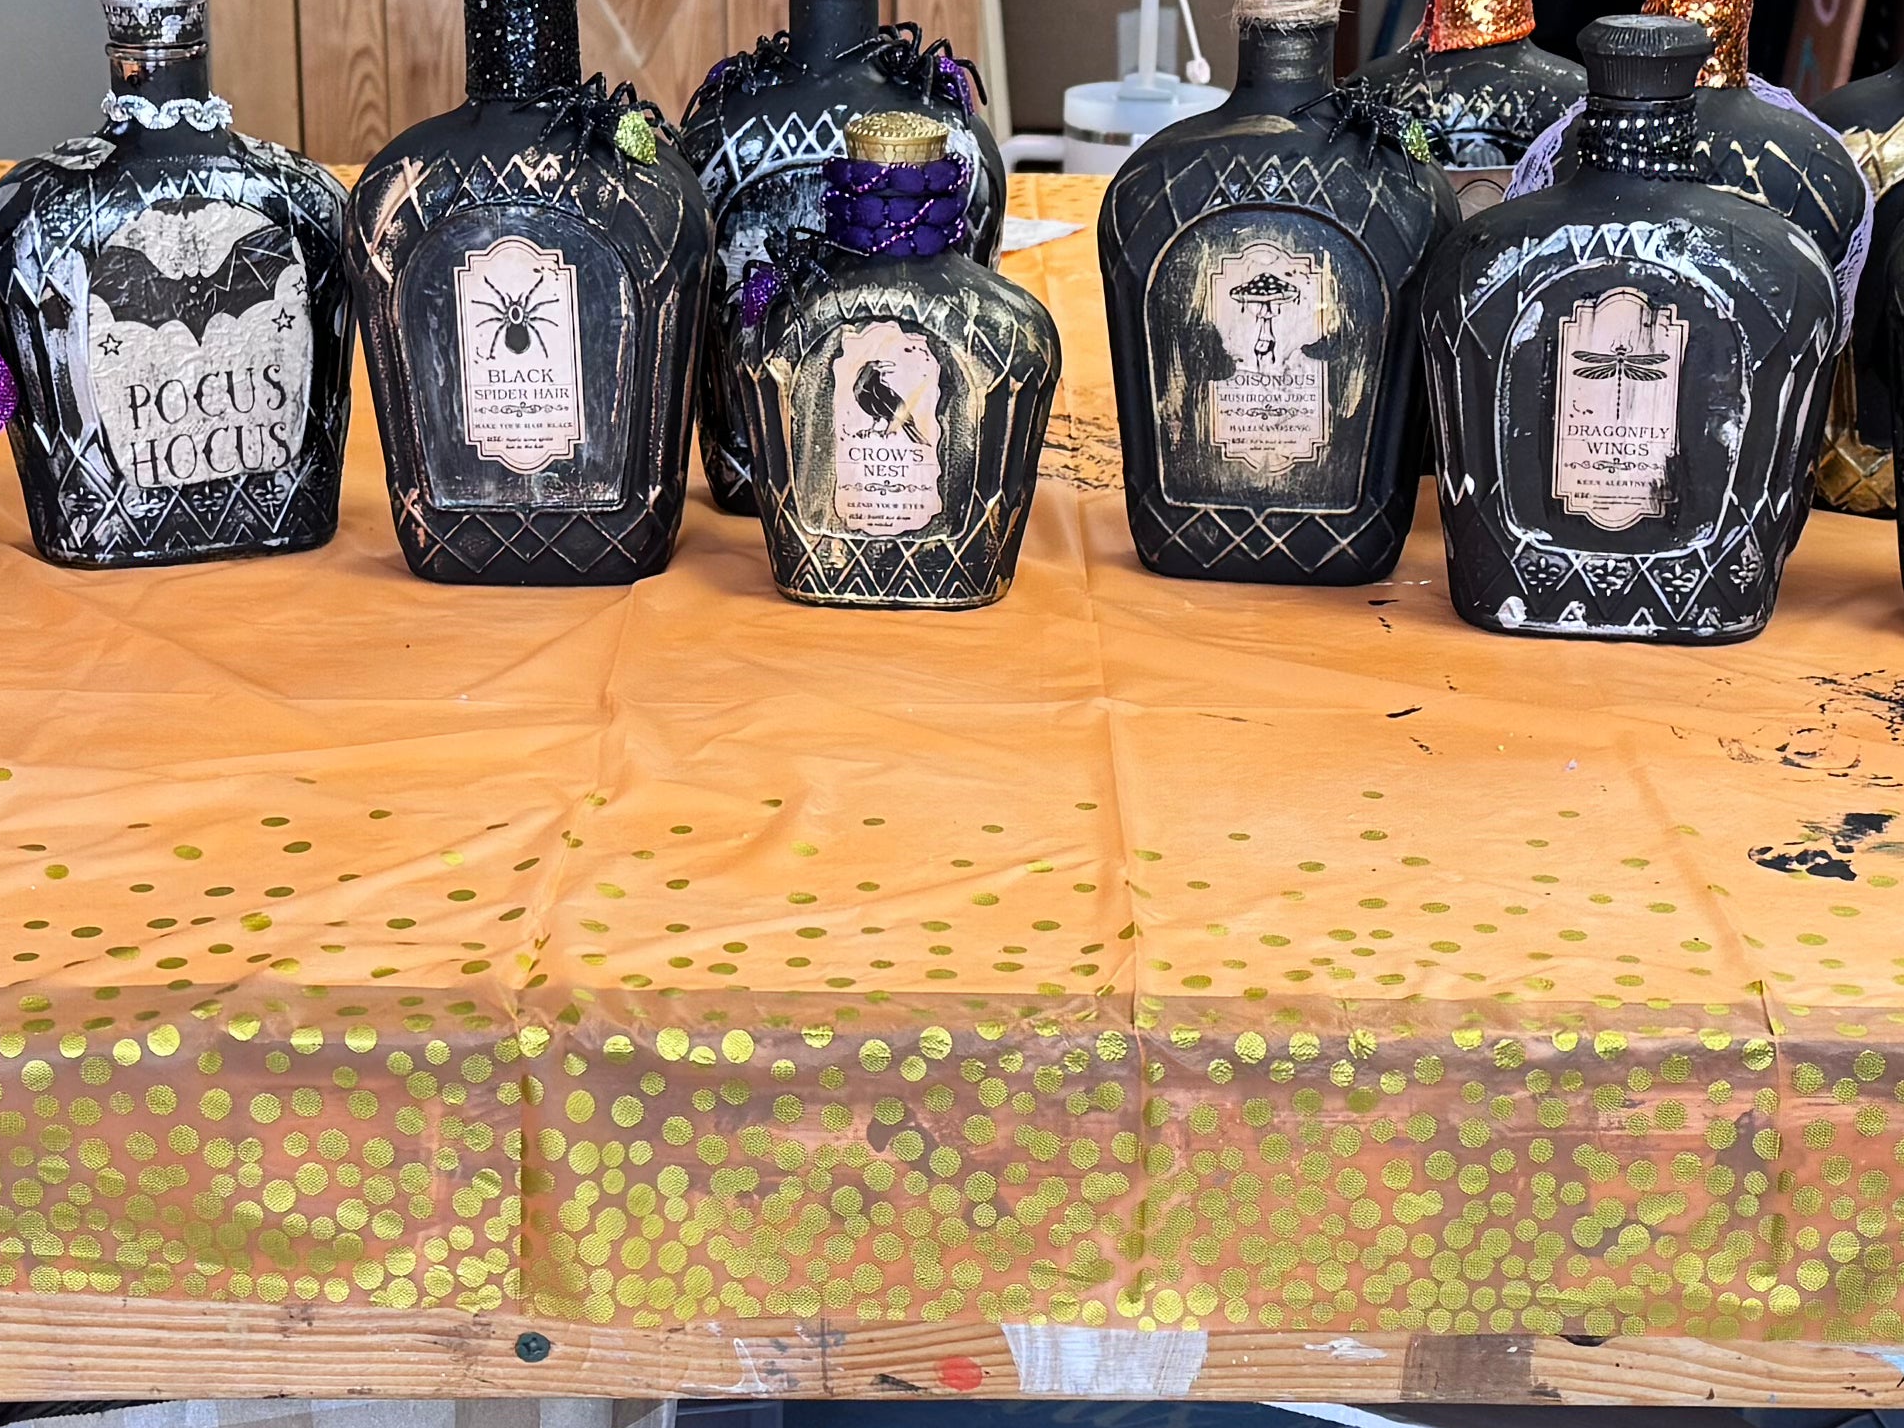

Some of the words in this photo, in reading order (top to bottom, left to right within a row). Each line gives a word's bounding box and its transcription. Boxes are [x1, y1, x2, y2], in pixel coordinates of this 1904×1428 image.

[488, 369, 555, 384] BLACK
[126, 364, 288, 430] POCUS
[474, 389, 528, 400] SPIDER
[534, 388, 570, 399] HAIR
[1567, 424, 1670, 439] DRAGONFLY
[130, 422, 292, 486] HOCUS
[848, 447, 925, 463] CROW'S
[1587, 442, 1649, 457] WINGS
[863, 464, 909, 478] NEST
